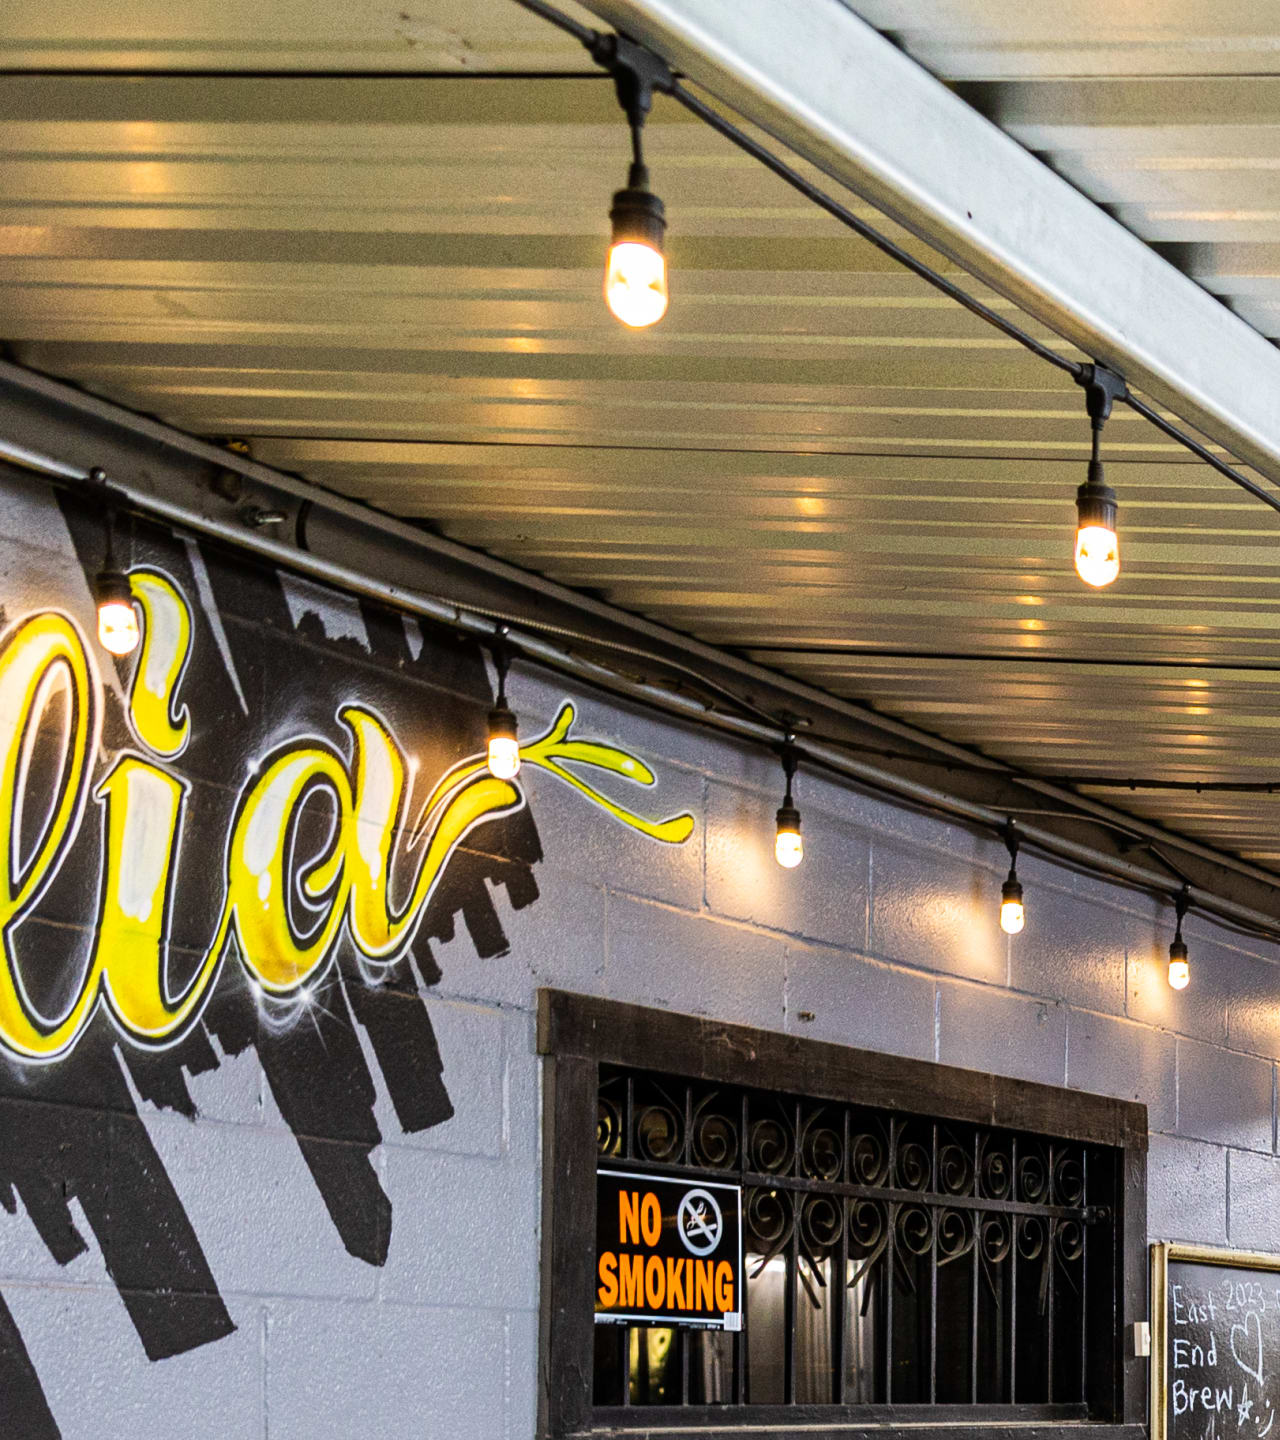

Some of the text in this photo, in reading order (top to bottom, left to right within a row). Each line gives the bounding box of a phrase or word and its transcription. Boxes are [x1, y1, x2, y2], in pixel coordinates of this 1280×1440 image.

[619, 1189, 662, 1248] NO
[598, 1250, 735, 1314] SMOKING
[1222, 1279, 1266, 1313] 2023
[1172, 1284, 1217, 1326] East
[1173, 1330, 1218, 1369] End
[1172, 1379, 1233, 1417] Brew
